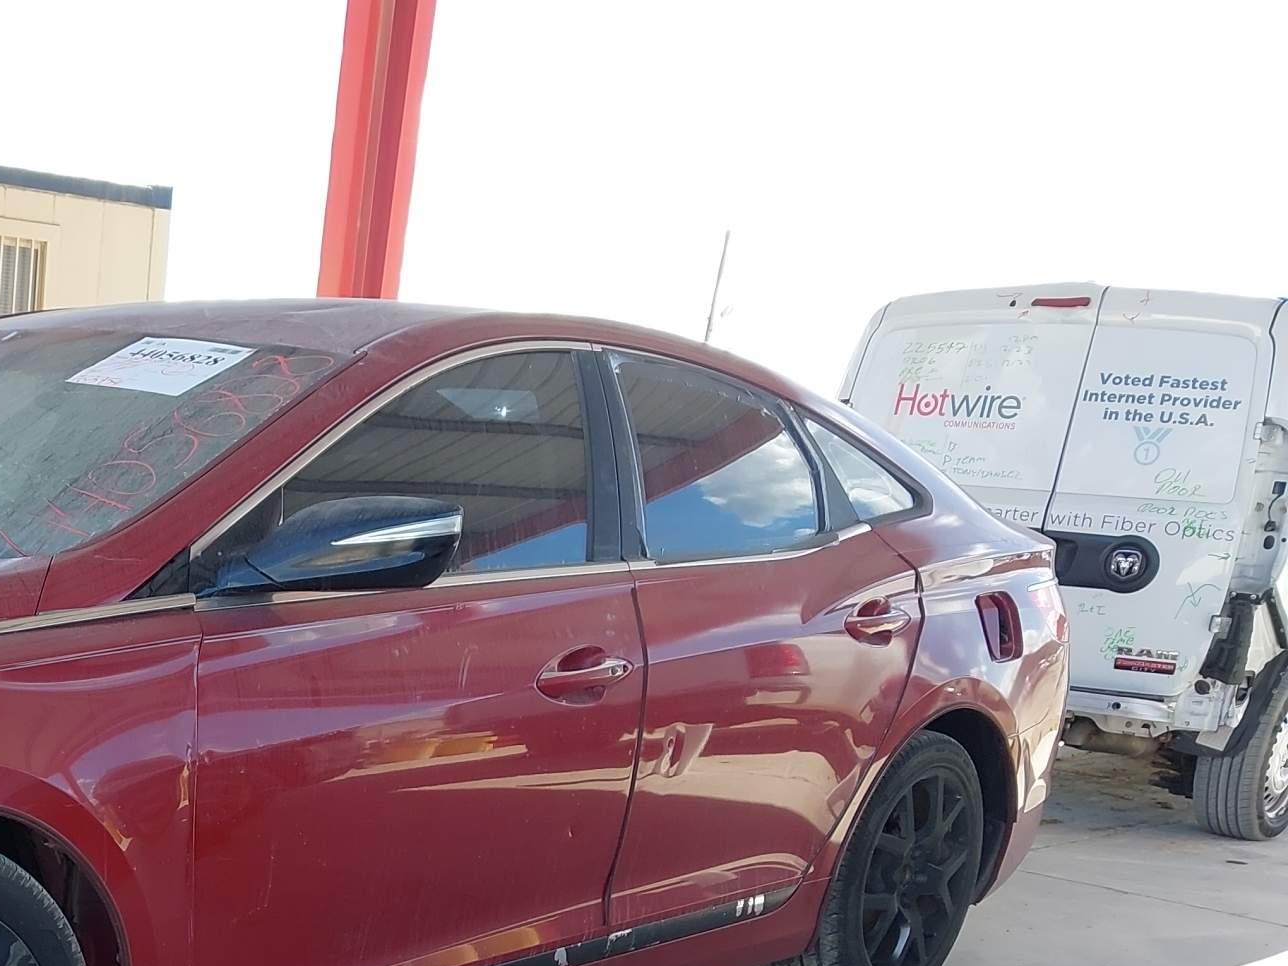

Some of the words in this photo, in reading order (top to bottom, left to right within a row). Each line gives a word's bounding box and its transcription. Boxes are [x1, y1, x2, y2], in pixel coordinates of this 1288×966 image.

[128, 346, 226, 366] 44056828
[1099, 372, 1155, 388] Voted
[1158, 375, 1229, 392] Fastest
[893, 384, 1023, 420] Hotwire
[1082, 389, 1156, 405] Internet
[1159, 393, 1243, 411] Provider
[943, 419, 1016, 430] COMMUNICATIONS
[1102, 407, 1120, 421] in
[1124, 408, 1154, 423] the
[1159, 410, 1215, 427] U.S.A.
[986, 507, 1040, 522] arter
[1049, 510, 1094, 530] with
[1100, 514, 1157, 534] Fiber
[1164, 519, 1235, 543] Optics
[1117, 646, 1179, 661] RAM
